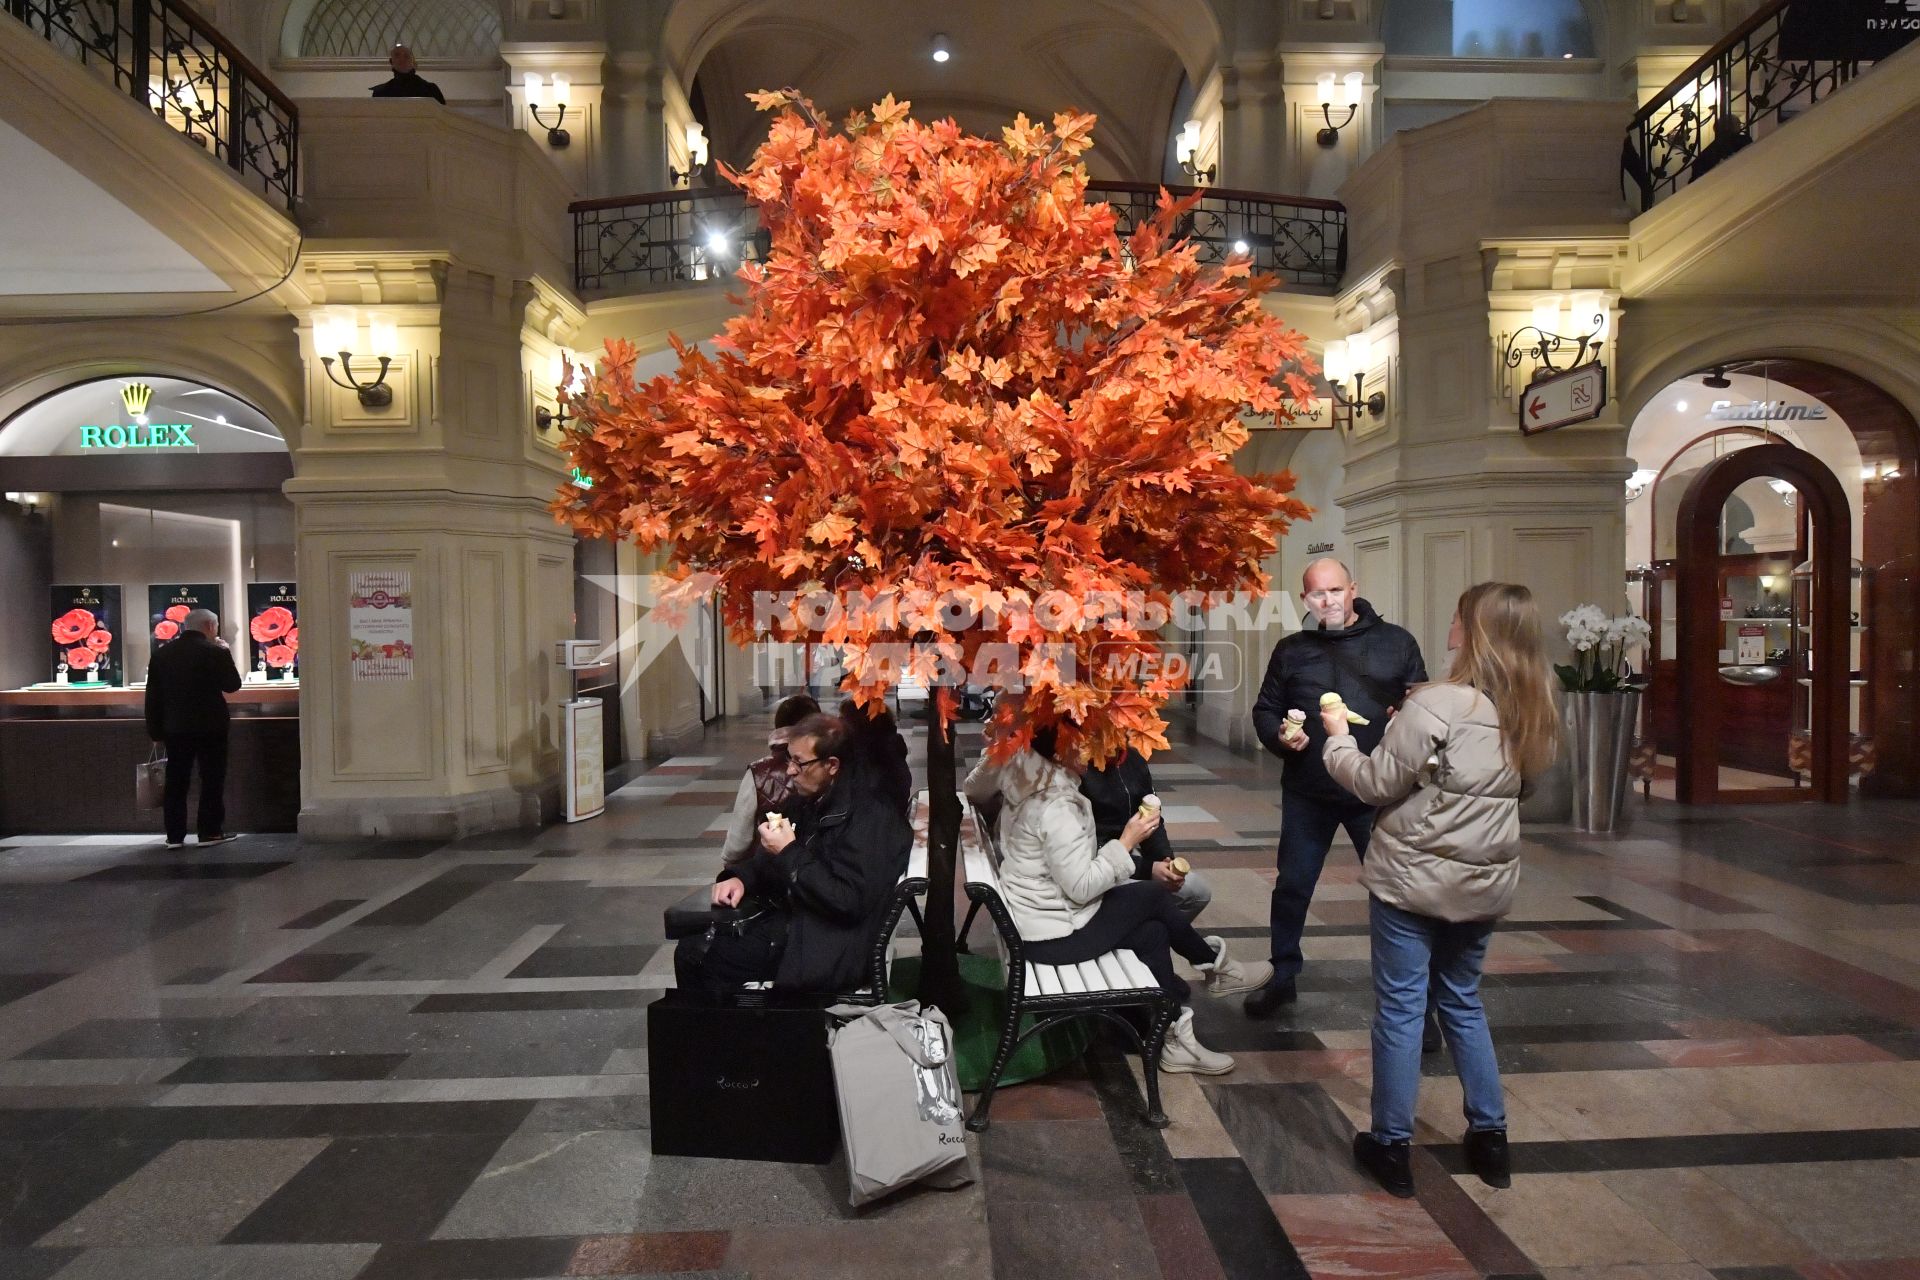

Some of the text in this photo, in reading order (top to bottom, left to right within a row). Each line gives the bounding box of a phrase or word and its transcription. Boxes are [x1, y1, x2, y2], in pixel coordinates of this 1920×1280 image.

[1704, 400, 1828, 421] Sublime
[80, 424, 195, 448] ROLEX
[1305, 542, 1335, 555] Sublime
[171, 596, 198, 604] ROLEX
[938, 1132, 966, 1146] Rocco
